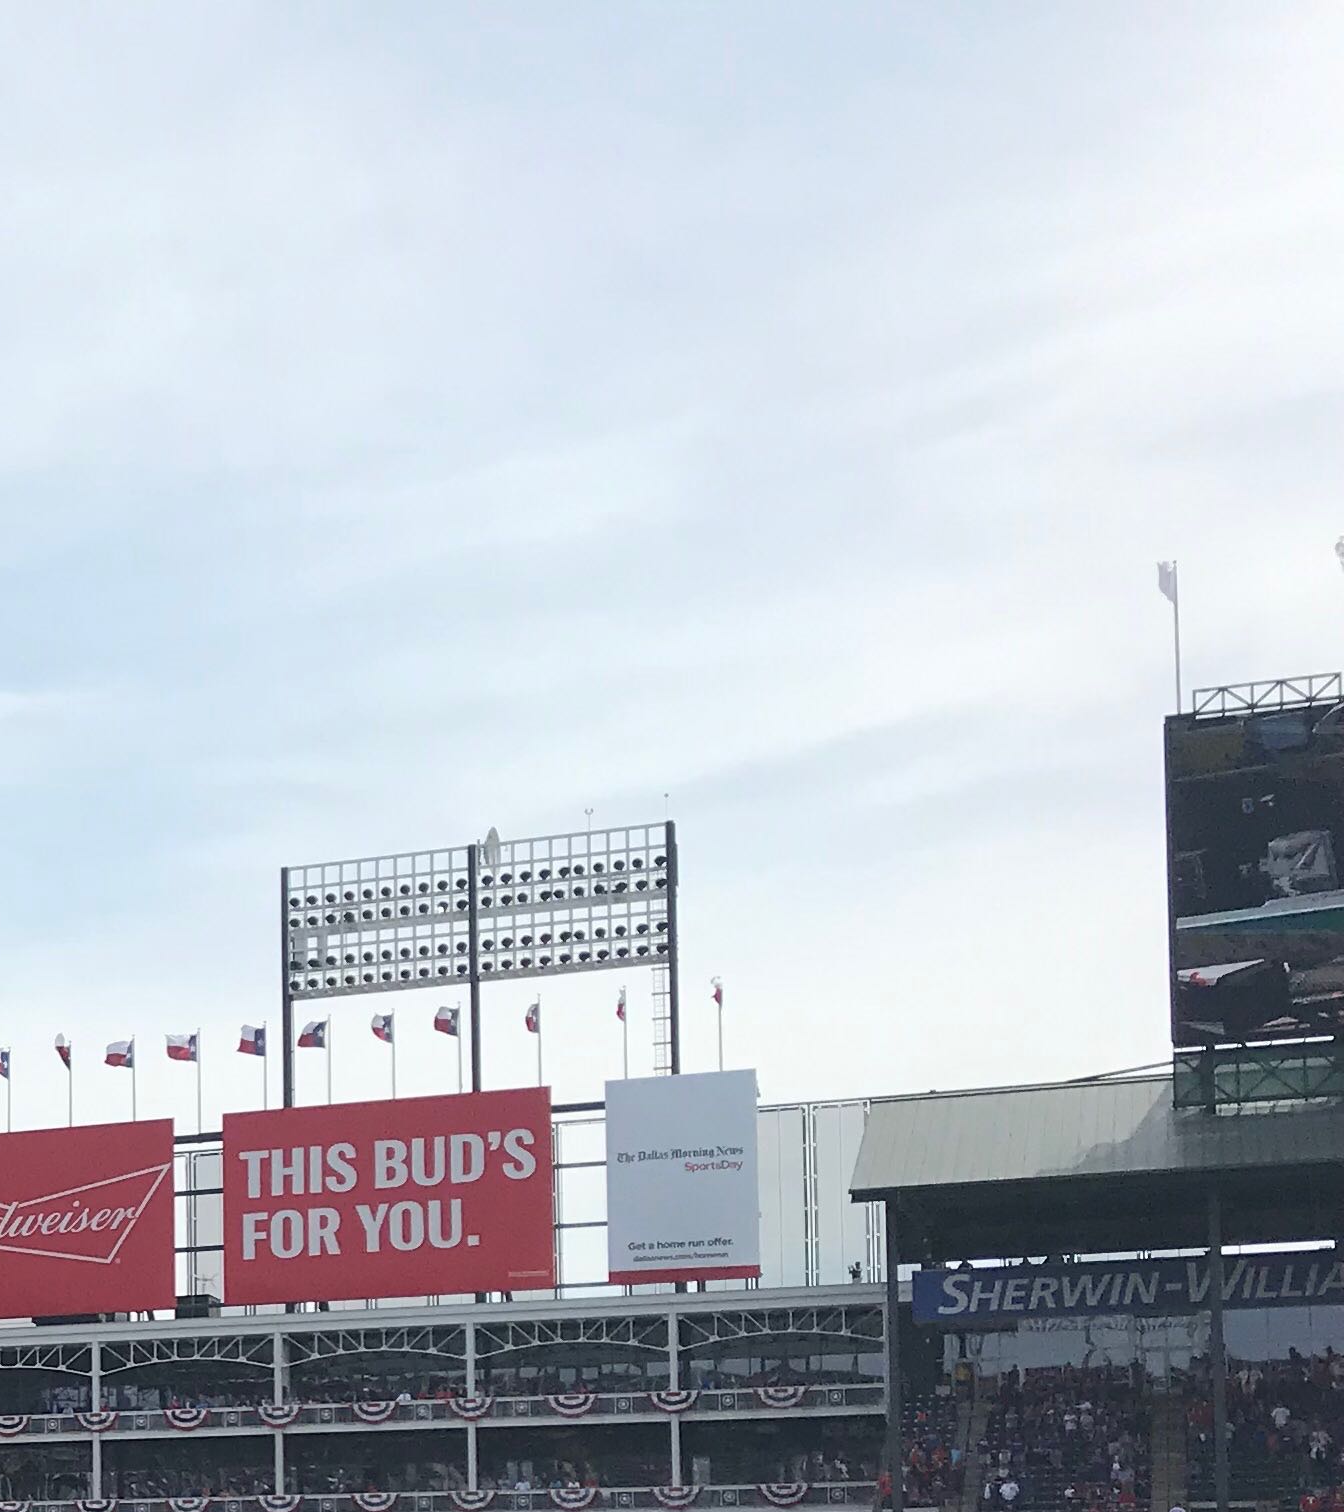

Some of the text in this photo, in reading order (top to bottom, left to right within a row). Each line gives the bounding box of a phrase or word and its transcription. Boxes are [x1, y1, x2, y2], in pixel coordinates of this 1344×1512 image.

[239, 1127, 537, 1199] THIS BUD'S
[617, 1146, 745, 1164] The Dallas Morning News
[242, 1197, 481, 1261] FOR YOU.
[627, 1242, 647, 1252] Get
[656, 1241, 686, 1250] home
[687, 1239, 705, 1248] run
